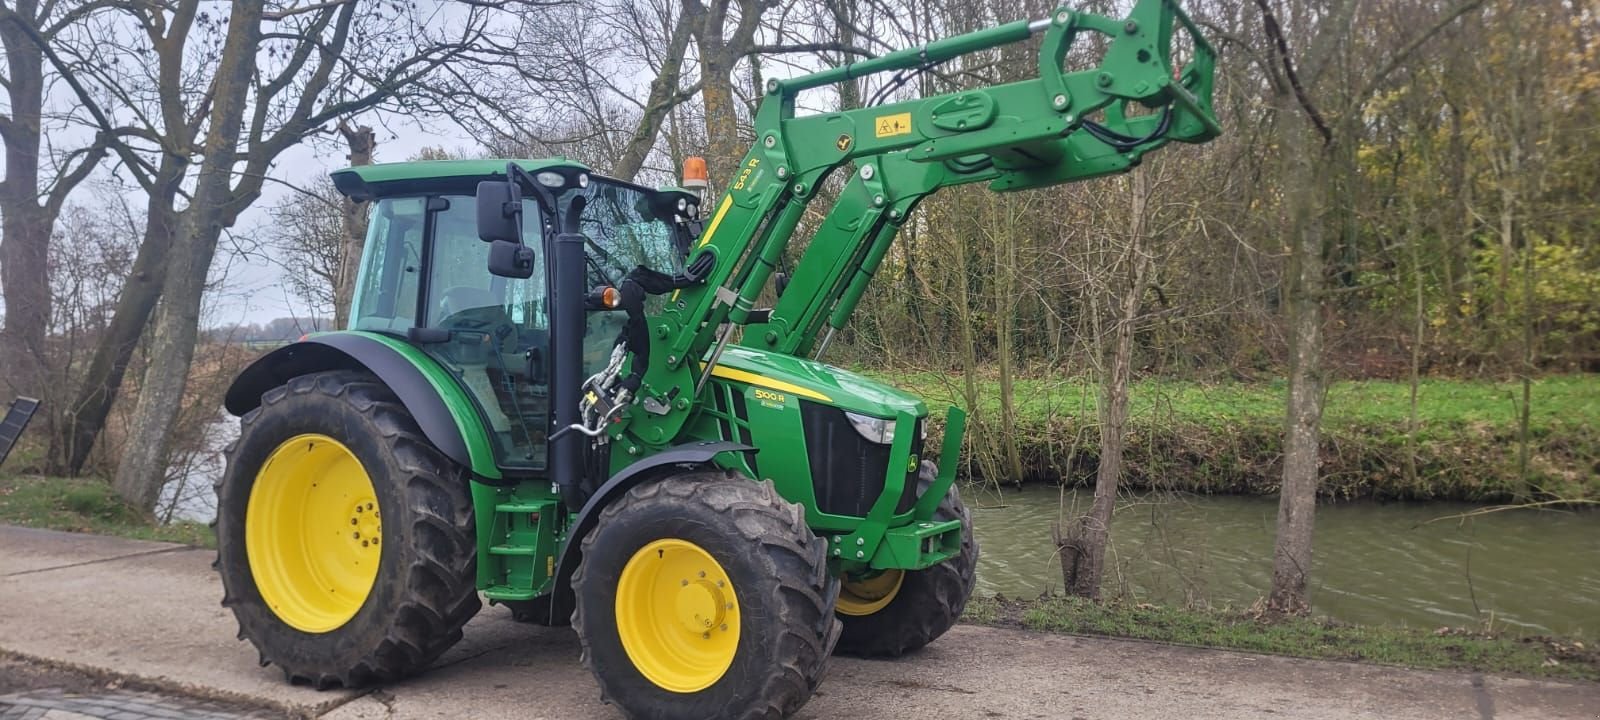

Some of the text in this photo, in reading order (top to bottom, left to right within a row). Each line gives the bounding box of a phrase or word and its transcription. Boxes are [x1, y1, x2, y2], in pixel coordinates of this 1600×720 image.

[733, 168, 752, 190] 543
[748, 158, 760, 167] R
[755, 389, 785, 403] 5100 R
